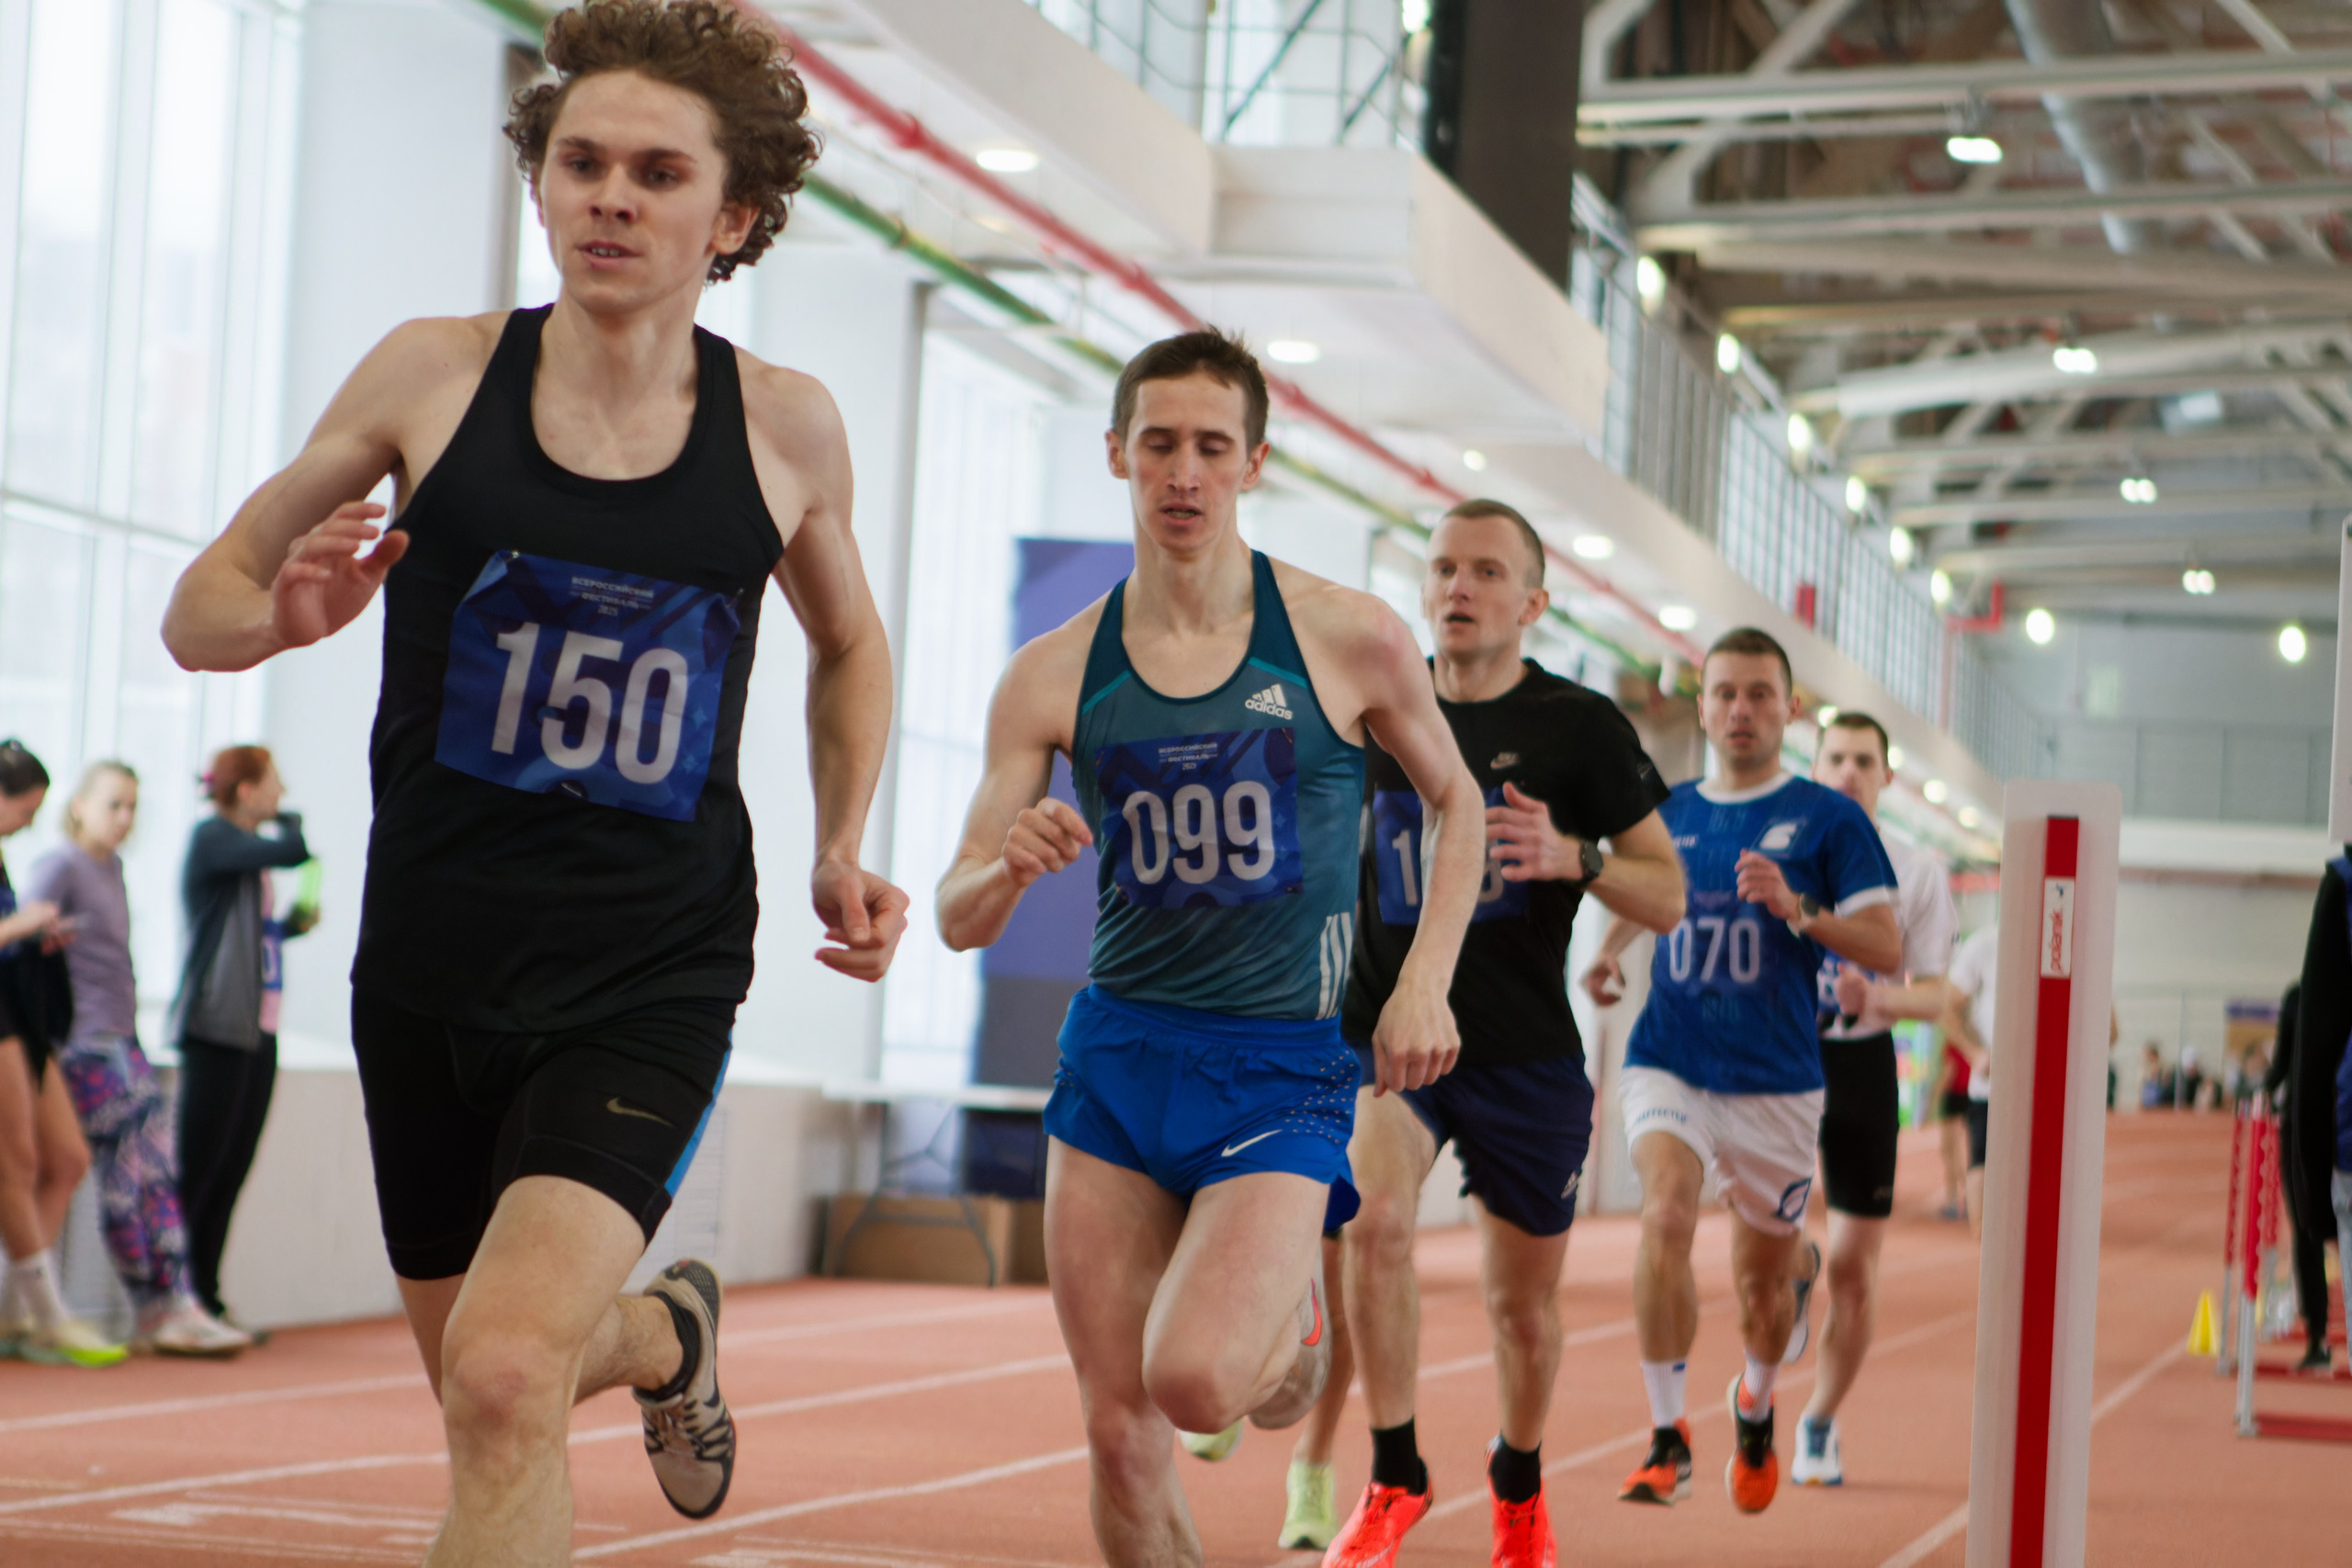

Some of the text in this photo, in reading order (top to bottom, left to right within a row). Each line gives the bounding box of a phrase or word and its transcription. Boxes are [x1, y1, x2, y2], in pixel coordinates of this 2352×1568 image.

[492, 622, 687, 784] 150
[1245, 699, 1293, 720] adidas
[1122, 781, 1275, 885] 099
[1668, 916, 1760, 983] 070
